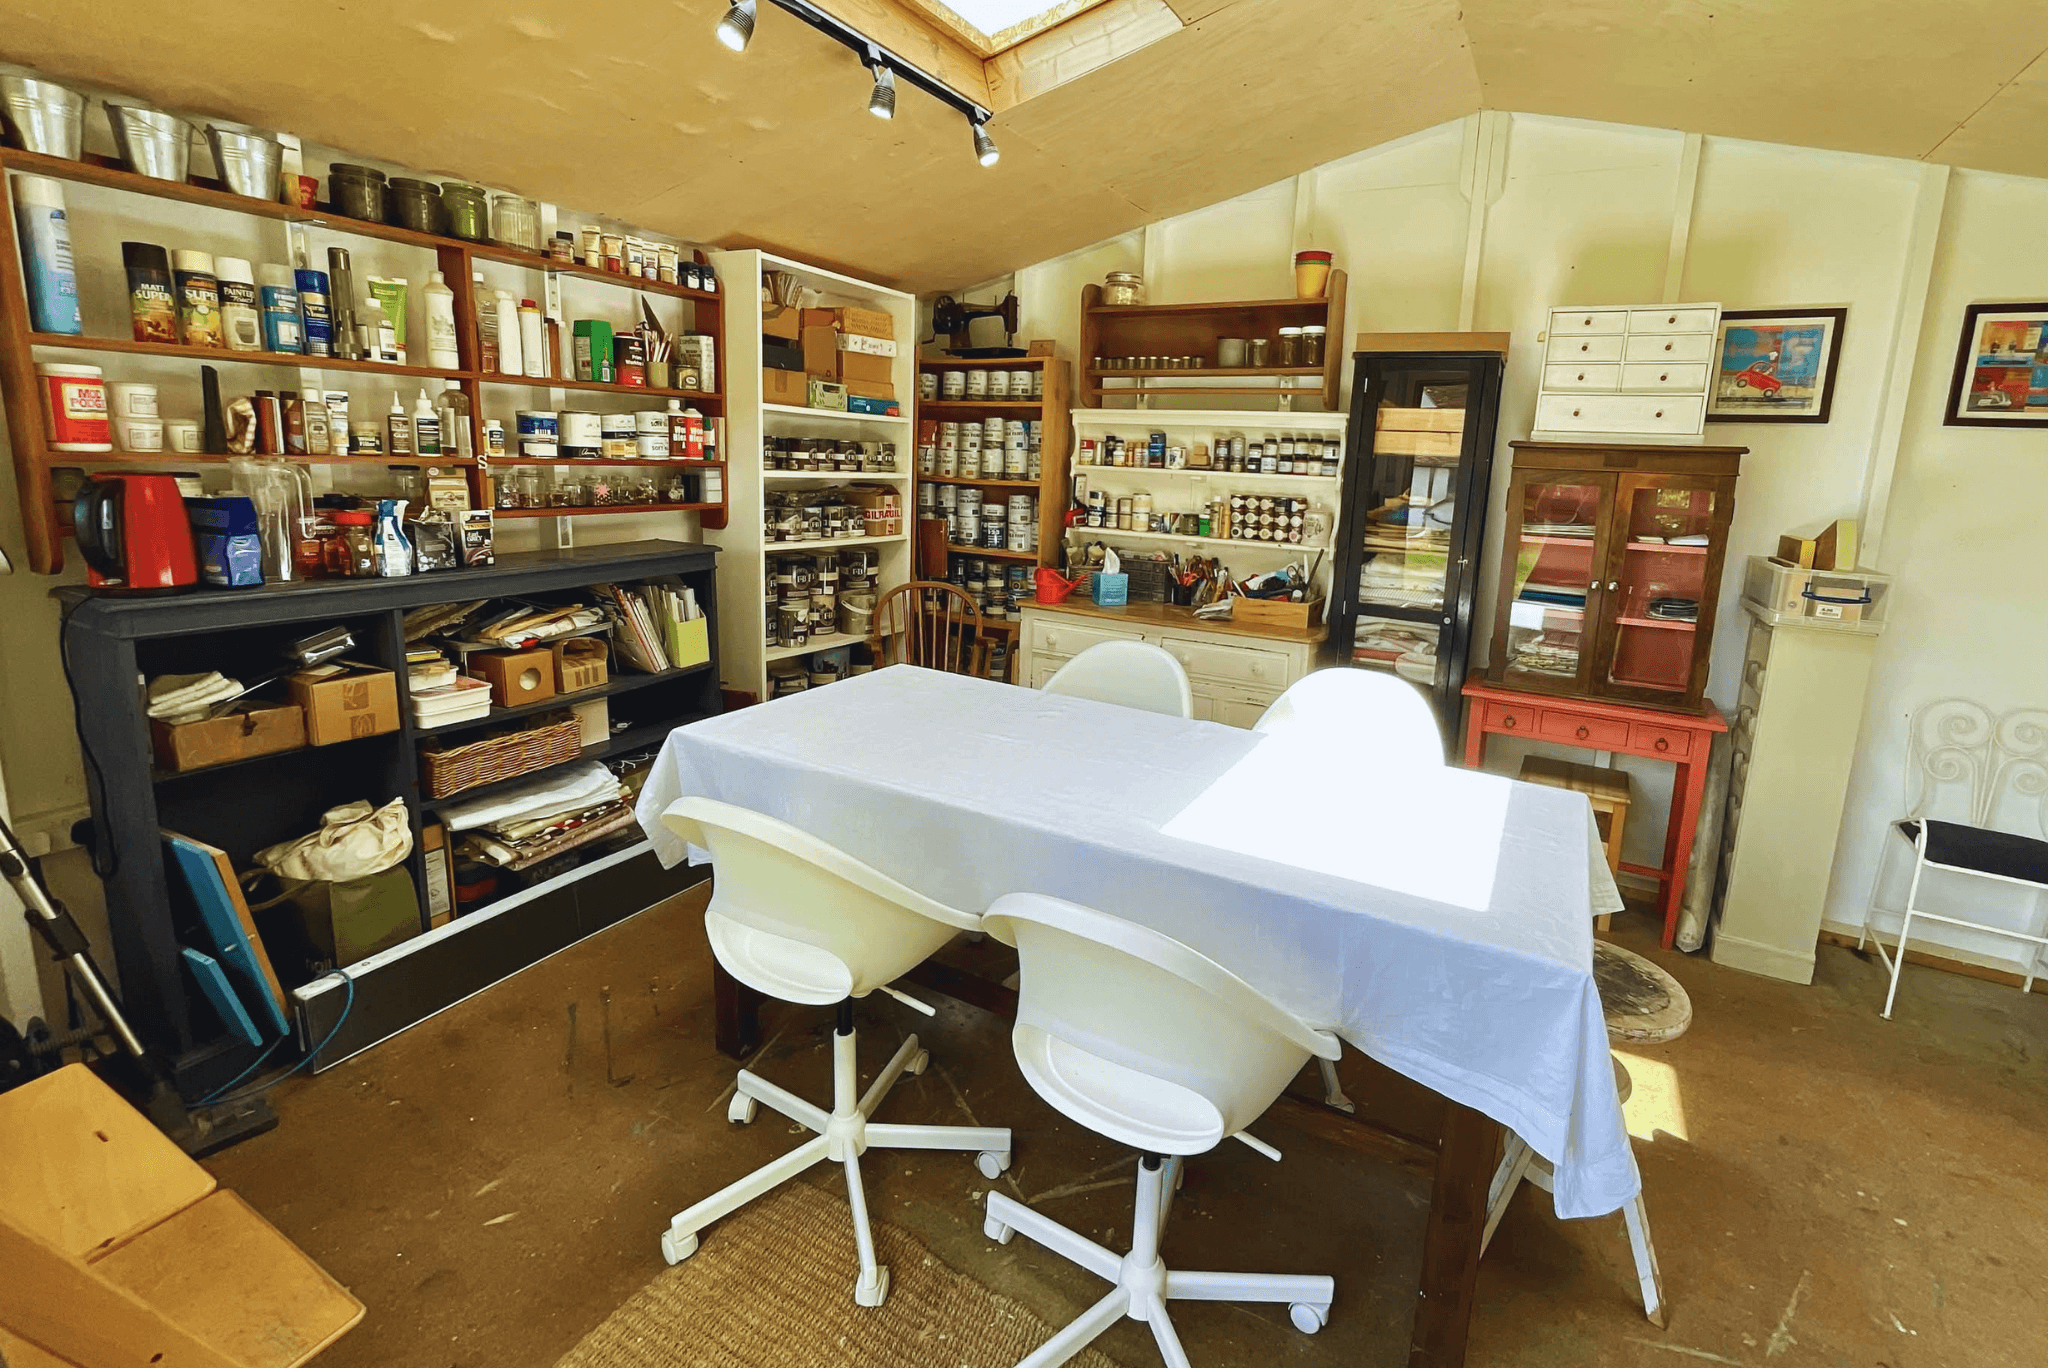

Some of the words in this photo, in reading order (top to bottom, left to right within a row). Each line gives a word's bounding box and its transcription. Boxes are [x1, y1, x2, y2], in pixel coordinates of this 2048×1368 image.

[141, 283, 165, 292] MATT
[185, 289, 218, 302] SUPE
[70, 398, 106, 409] PODG
